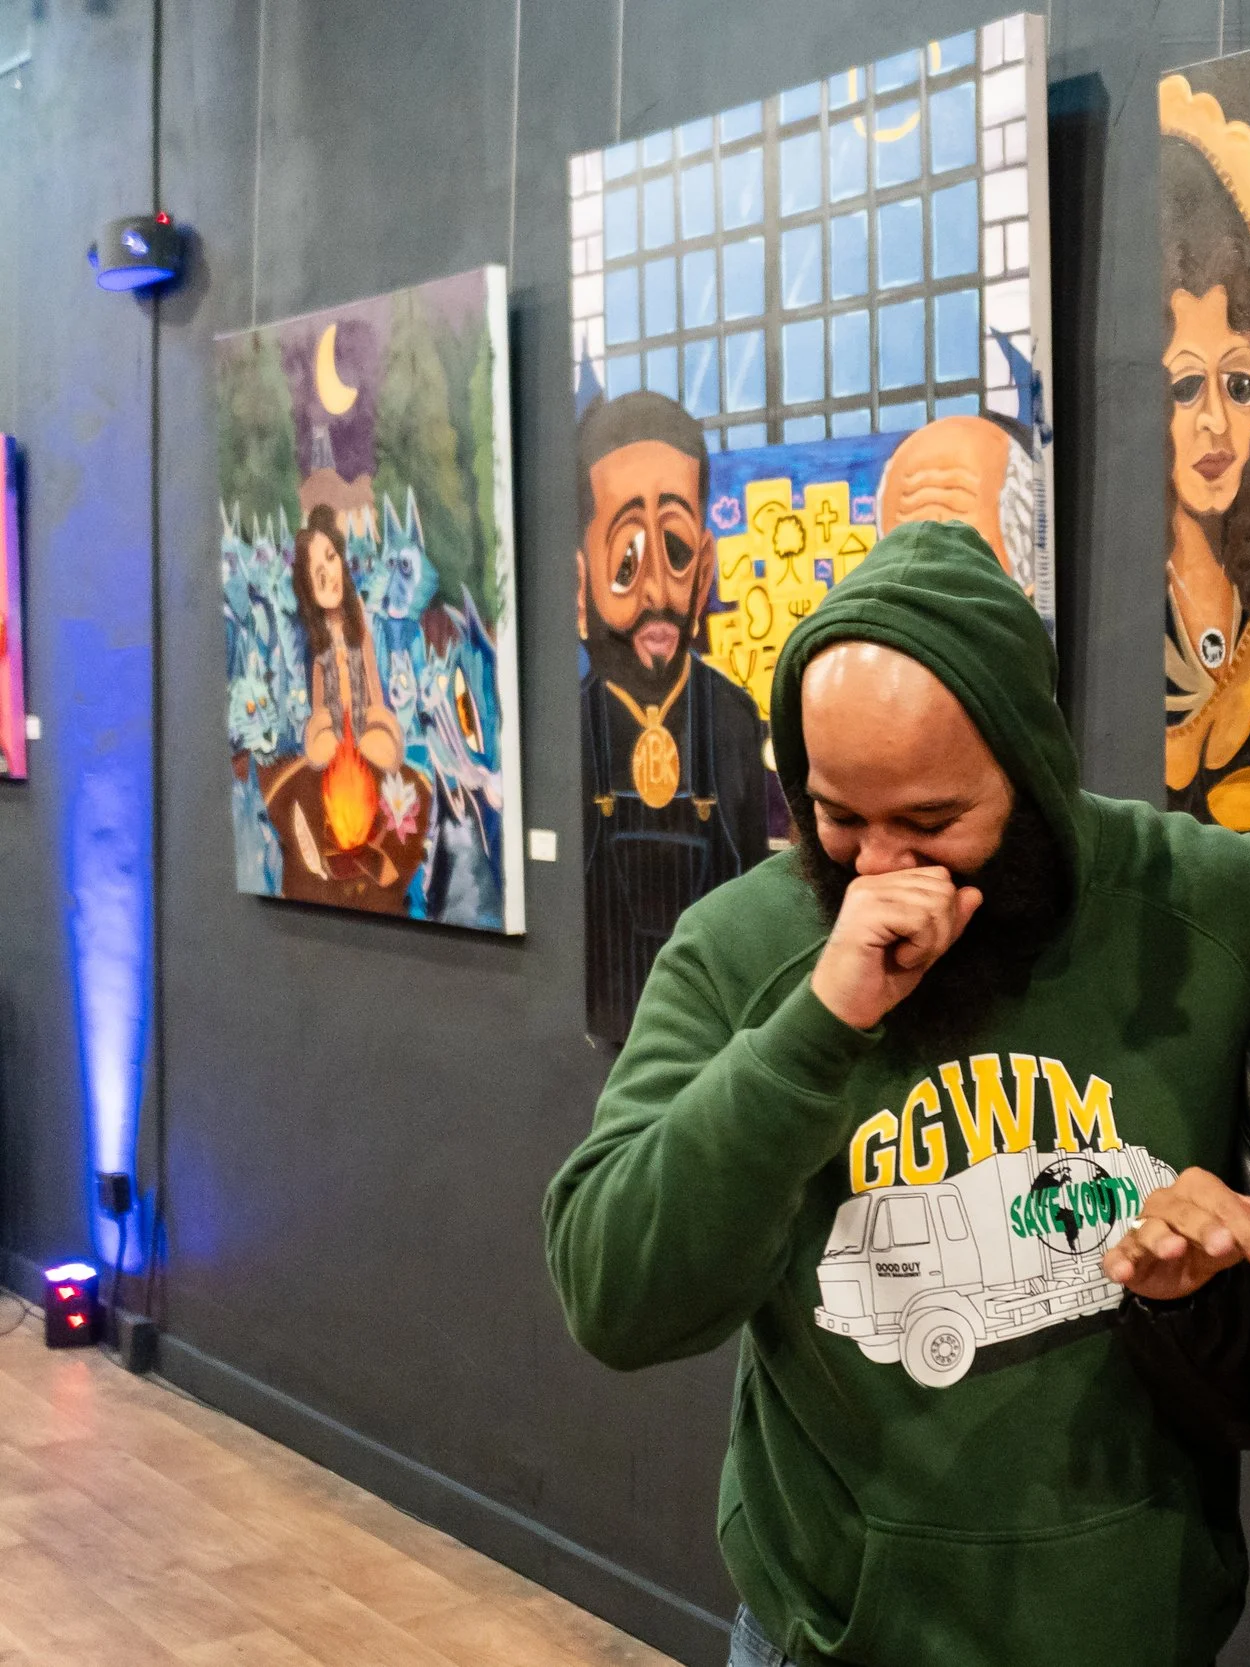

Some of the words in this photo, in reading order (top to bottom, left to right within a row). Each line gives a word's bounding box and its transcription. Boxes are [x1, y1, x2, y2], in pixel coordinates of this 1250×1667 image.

[849, 1053, 1122, 1194] GGWM
[1010, 1186, 1066, 1238] SAVE
[1066, 1176, 1140, 1229] YOUTH
[876, 1262, 900, 1272] GOOD
[901, 1262, 920, 1272] GUY
